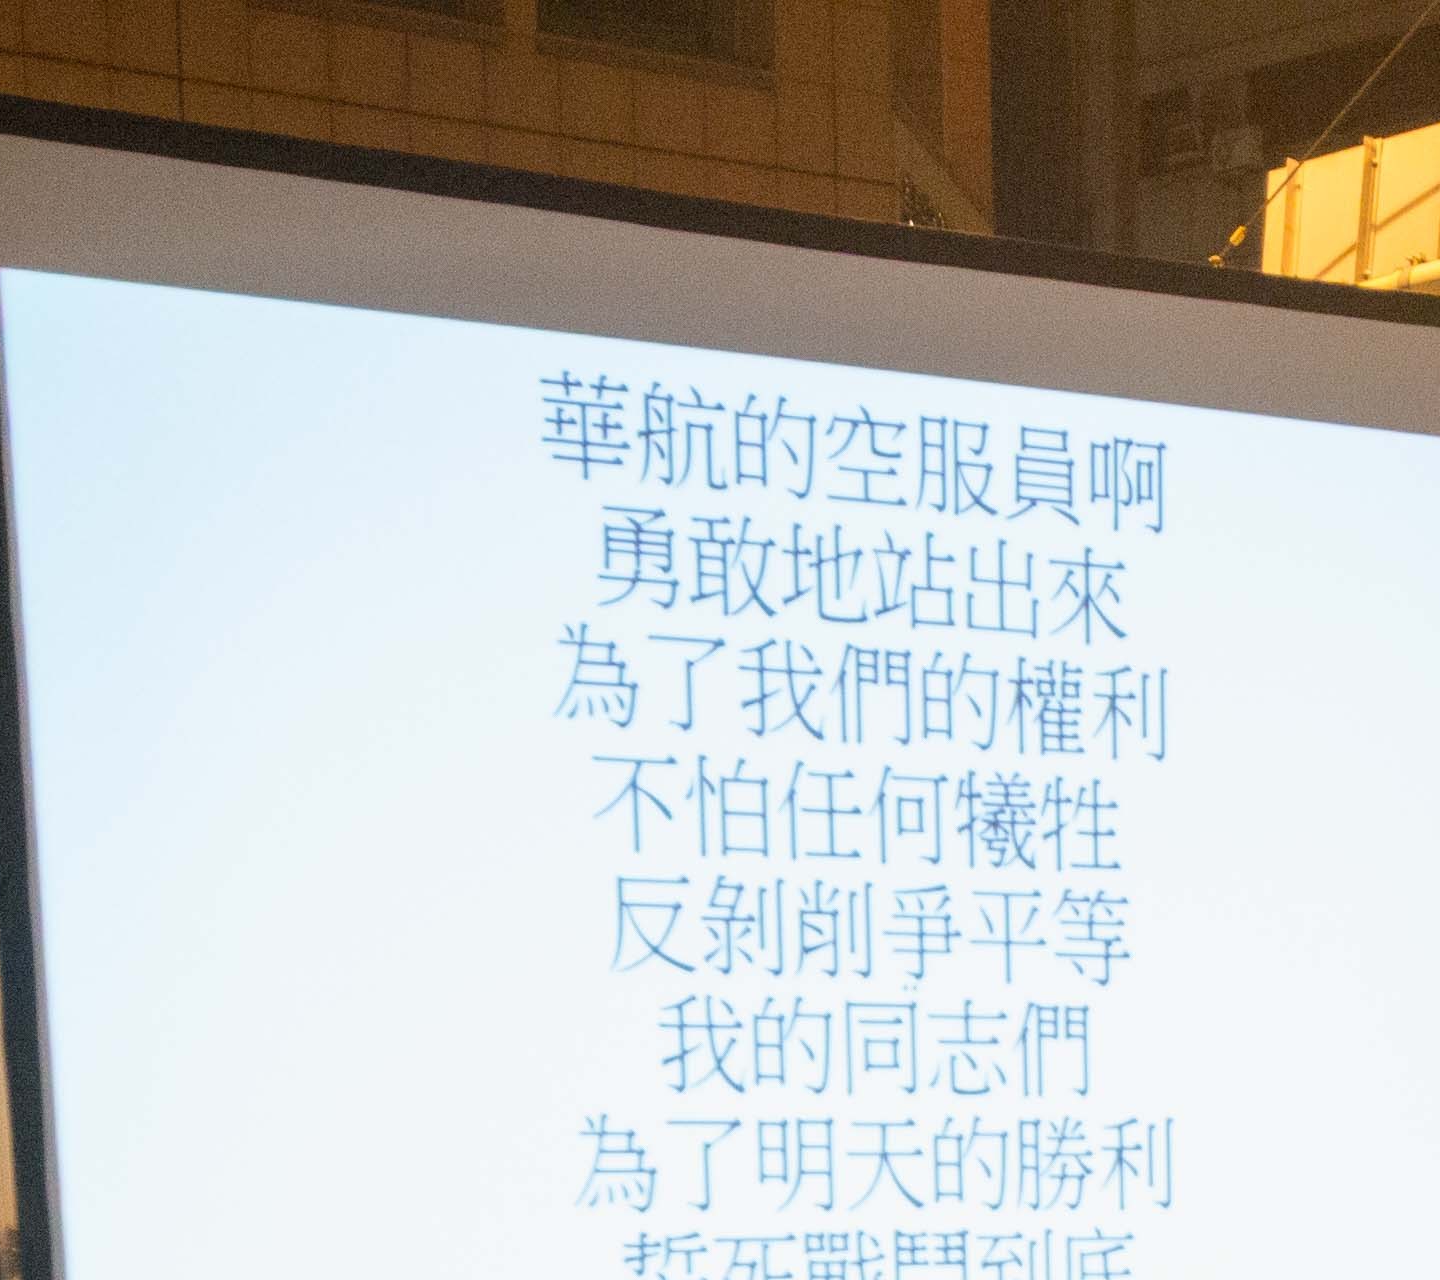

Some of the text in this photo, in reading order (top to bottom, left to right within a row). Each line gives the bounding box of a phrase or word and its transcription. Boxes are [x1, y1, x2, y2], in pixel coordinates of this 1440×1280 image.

[540, 370, 1168, 536] 華航的空服員啊
[597, 502, 1129, 645] 勇敢地站出來
[552, 623, 1168, 762] 為了我們的權利
[593, 753, 1121, 872] 不怕任何犧牲
[611, 876, 1131, 987] 反剝削爭平等
[659, 994, 1091, 1097] 我的同志們
[574, 1114, 1174, 1213] 為了明天的勝利
